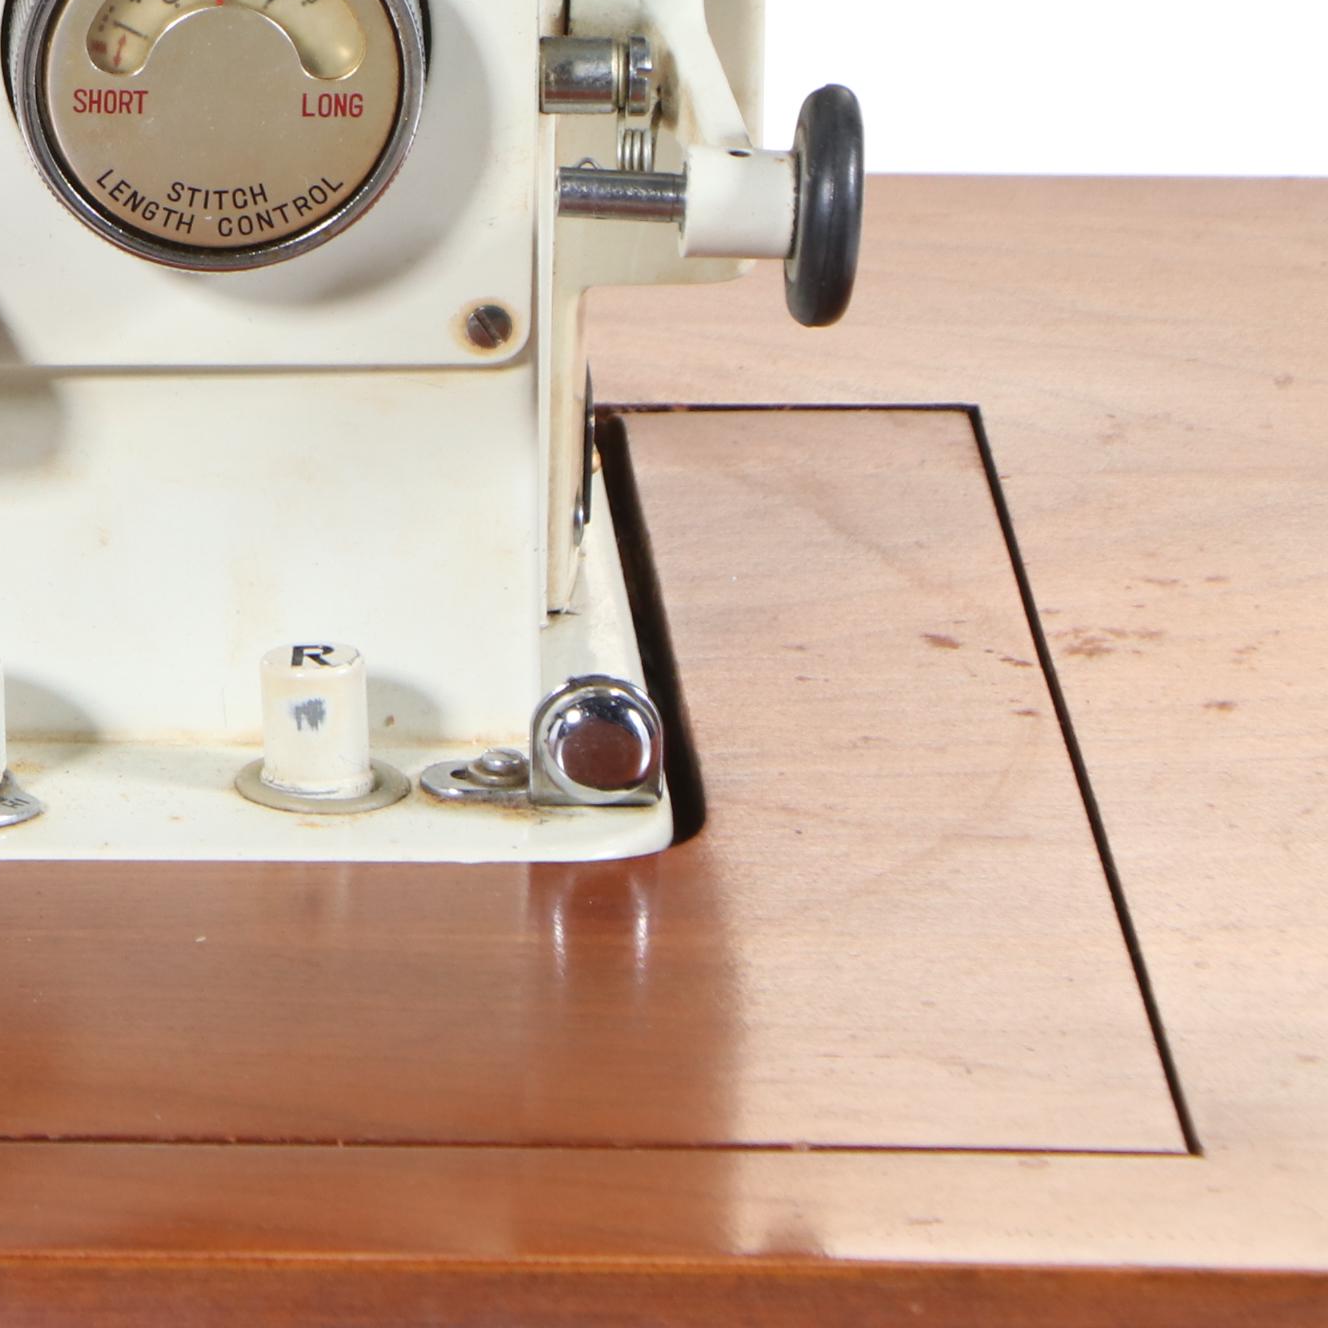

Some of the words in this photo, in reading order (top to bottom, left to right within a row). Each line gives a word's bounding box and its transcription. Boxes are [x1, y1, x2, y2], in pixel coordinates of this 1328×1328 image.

[72, 89, 149, 115] SHORT
[301, 92, 365, 119] LONG
[95, 168, 196, 235] LENGTH
[217, 176, 345, 237] CONTROL
[166, 181, 269, 211] STITCH
[290, 644, 335, 667] R
[1, 797, 32, 809] HI
